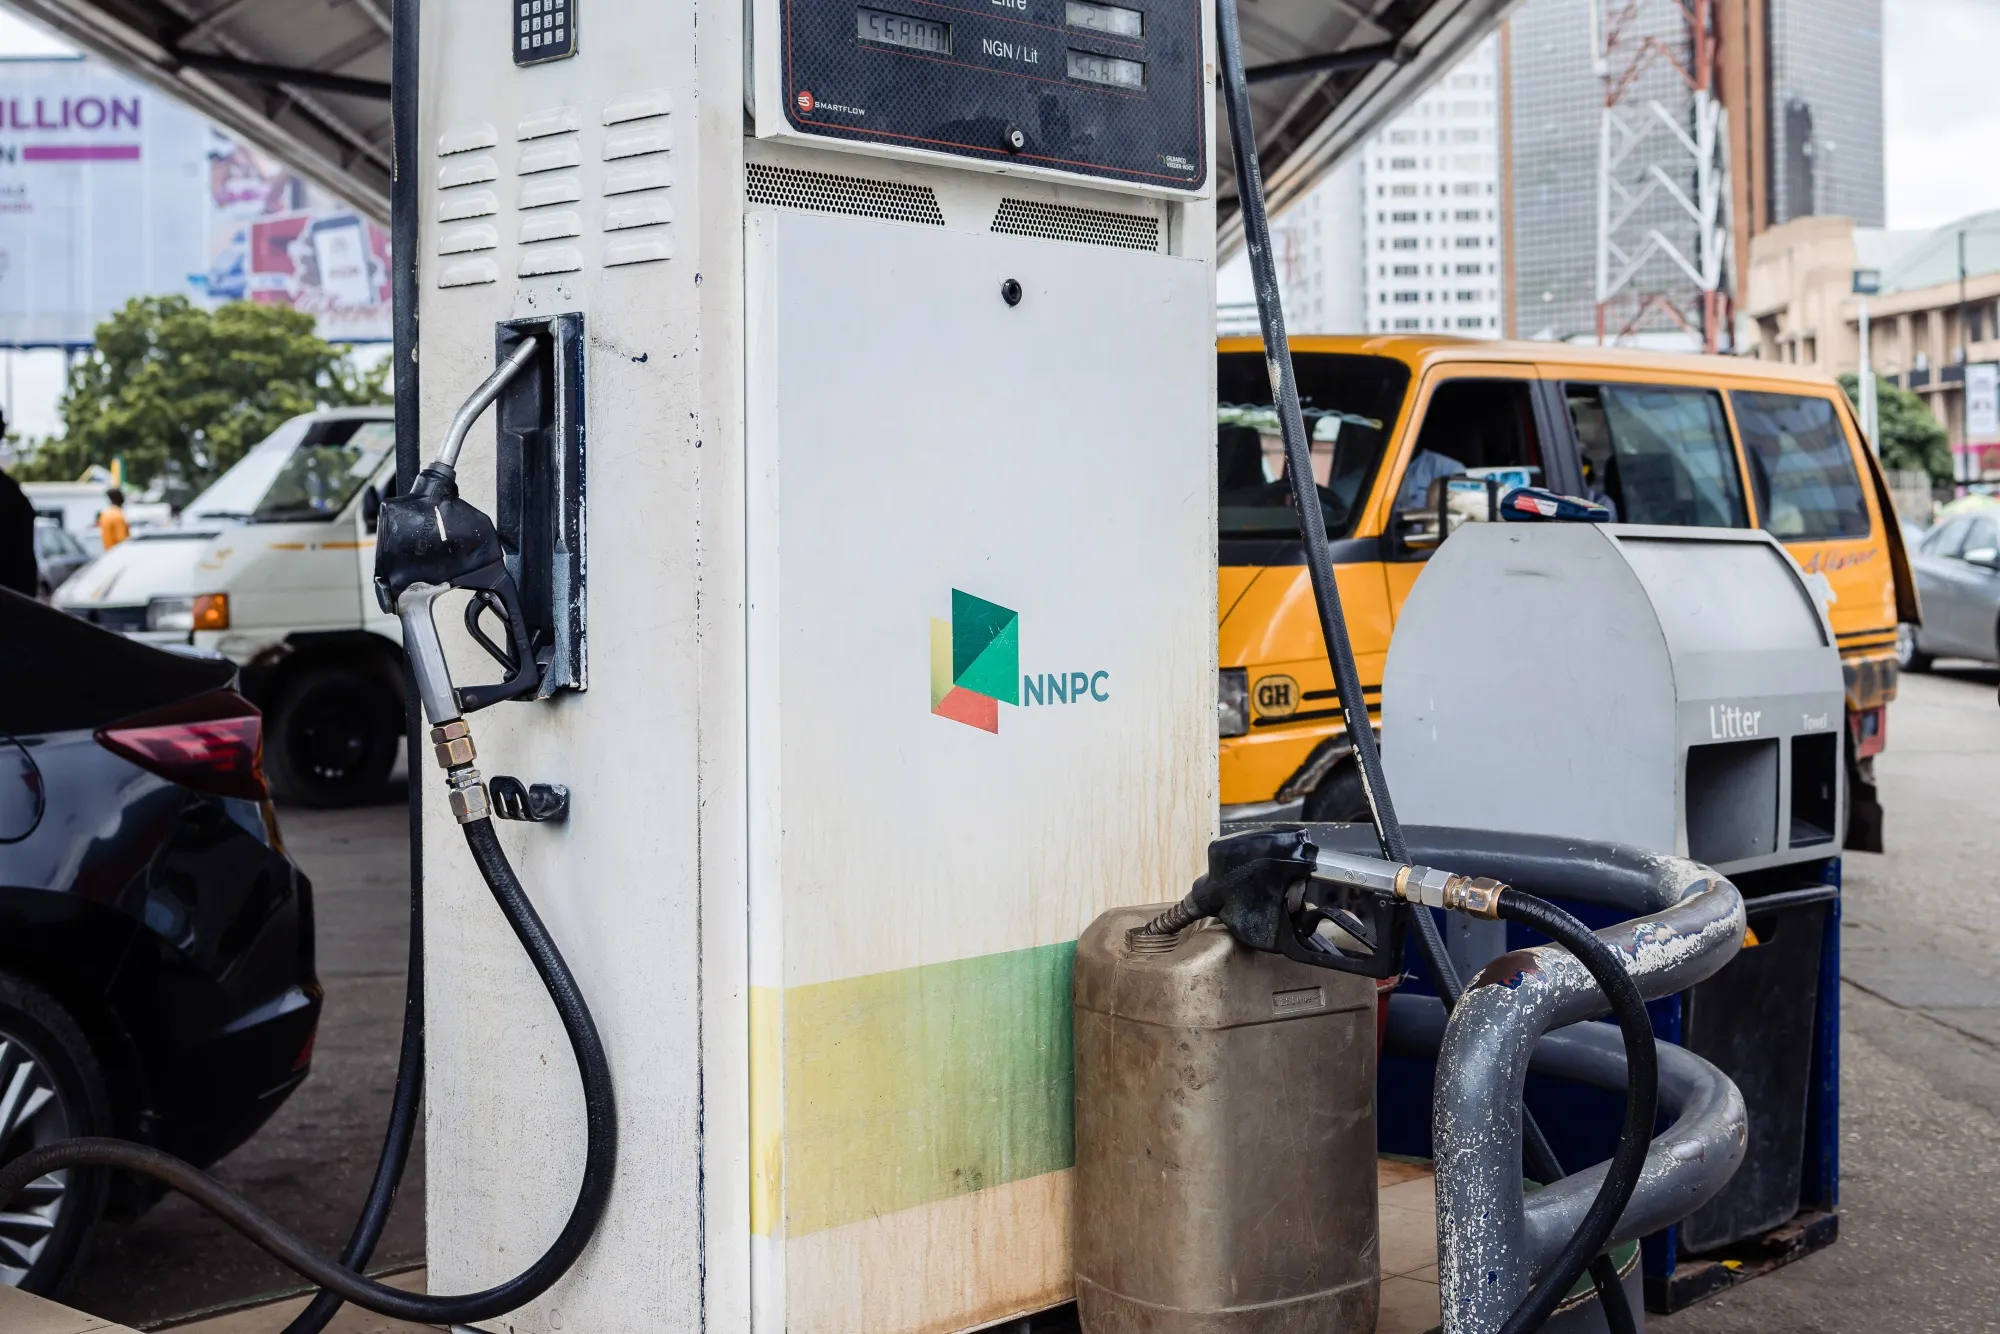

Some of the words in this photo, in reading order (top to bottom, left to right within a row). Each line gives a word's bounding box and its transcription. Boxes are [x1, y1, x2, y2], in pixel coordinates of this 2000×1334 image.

[983, 39, 1013, 59] NGN
[1016, 45, 1020, 60] /
[1023, 47, 1038, 64] Lit
[815, 101, 866, 116] SMARTFLOW
[1024, 670, 1110, 707] NNPC
[1259, 685, 1291, 708] GH
[1709, 704, 1762, 739] Litter
